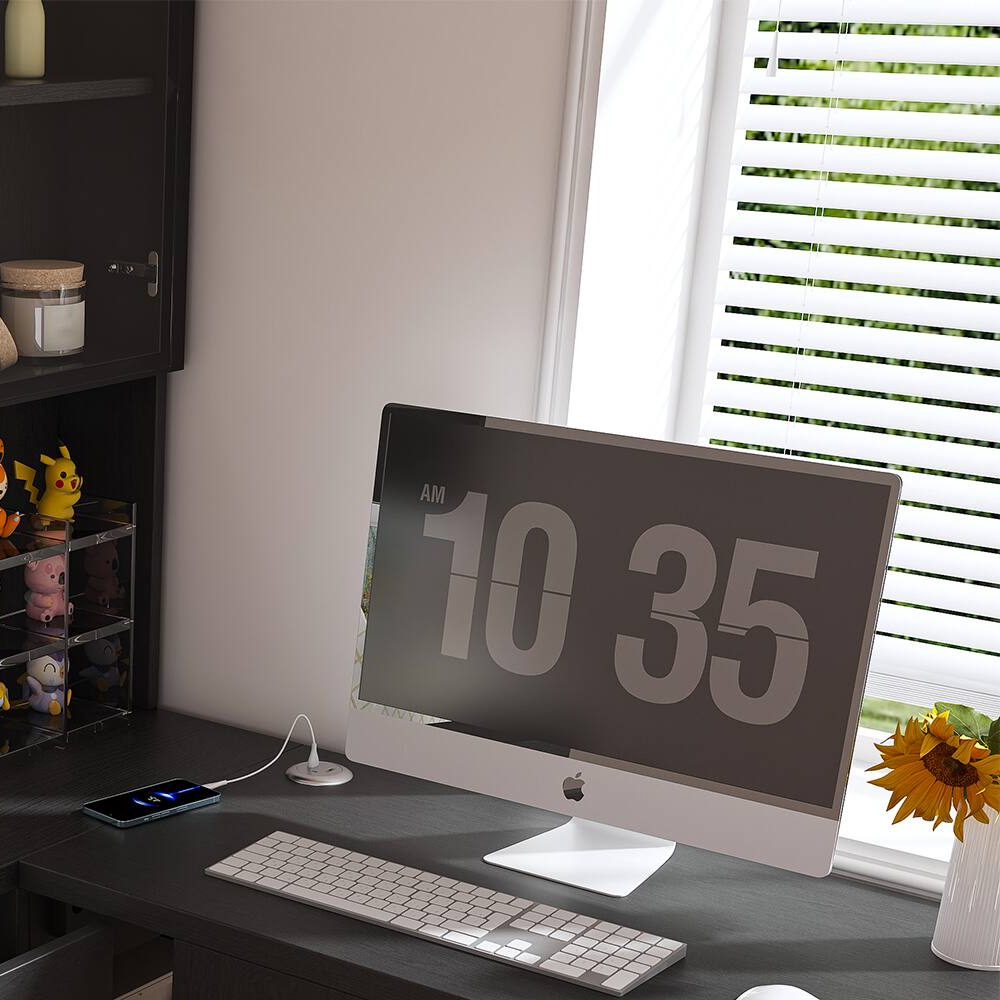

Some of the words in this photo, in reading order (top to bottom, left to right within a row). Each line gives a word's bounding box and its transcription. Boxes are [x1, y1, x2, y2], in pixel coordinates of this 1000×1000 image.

[420, 483, 446, 505] AM
[422, 491, 578, 677] 10
[614, 523, 820, 726] 35
